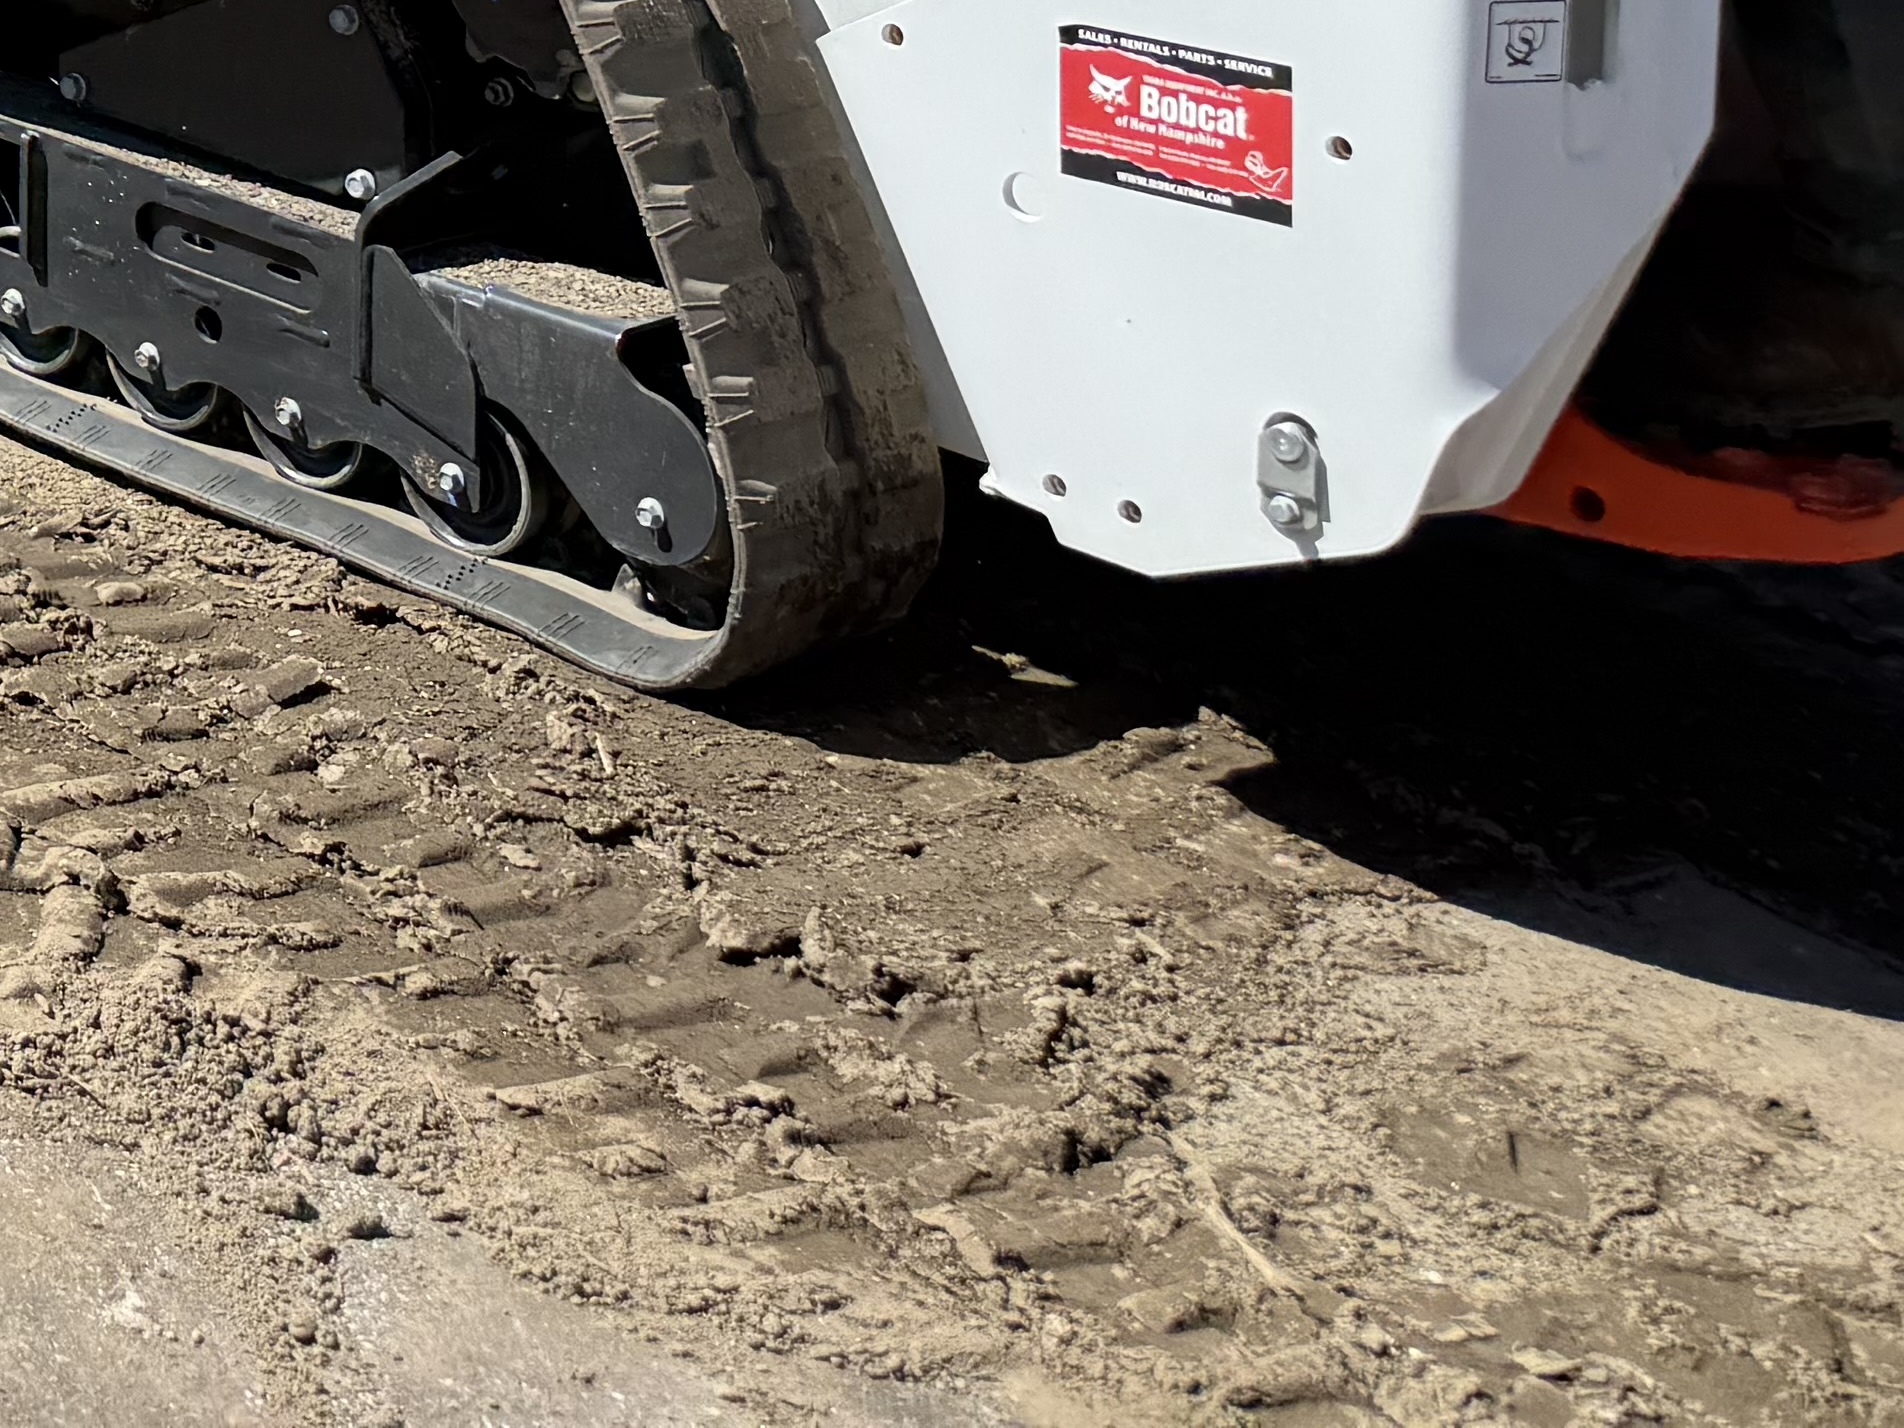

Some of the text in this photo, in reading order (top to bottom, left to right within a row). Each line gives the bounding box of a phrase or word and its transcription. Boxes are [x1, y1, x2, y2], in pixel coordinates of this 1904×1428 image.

[1077, 28, 1273, 78] SALES RENTALS PARTS SERVICE
[1114, 115, 1129, 128] of
[1129, 116, 1157, 134] New
[1157, 122, 1226, 150] Hampshire
[1139, 83, 1249, 141] Bobcat
